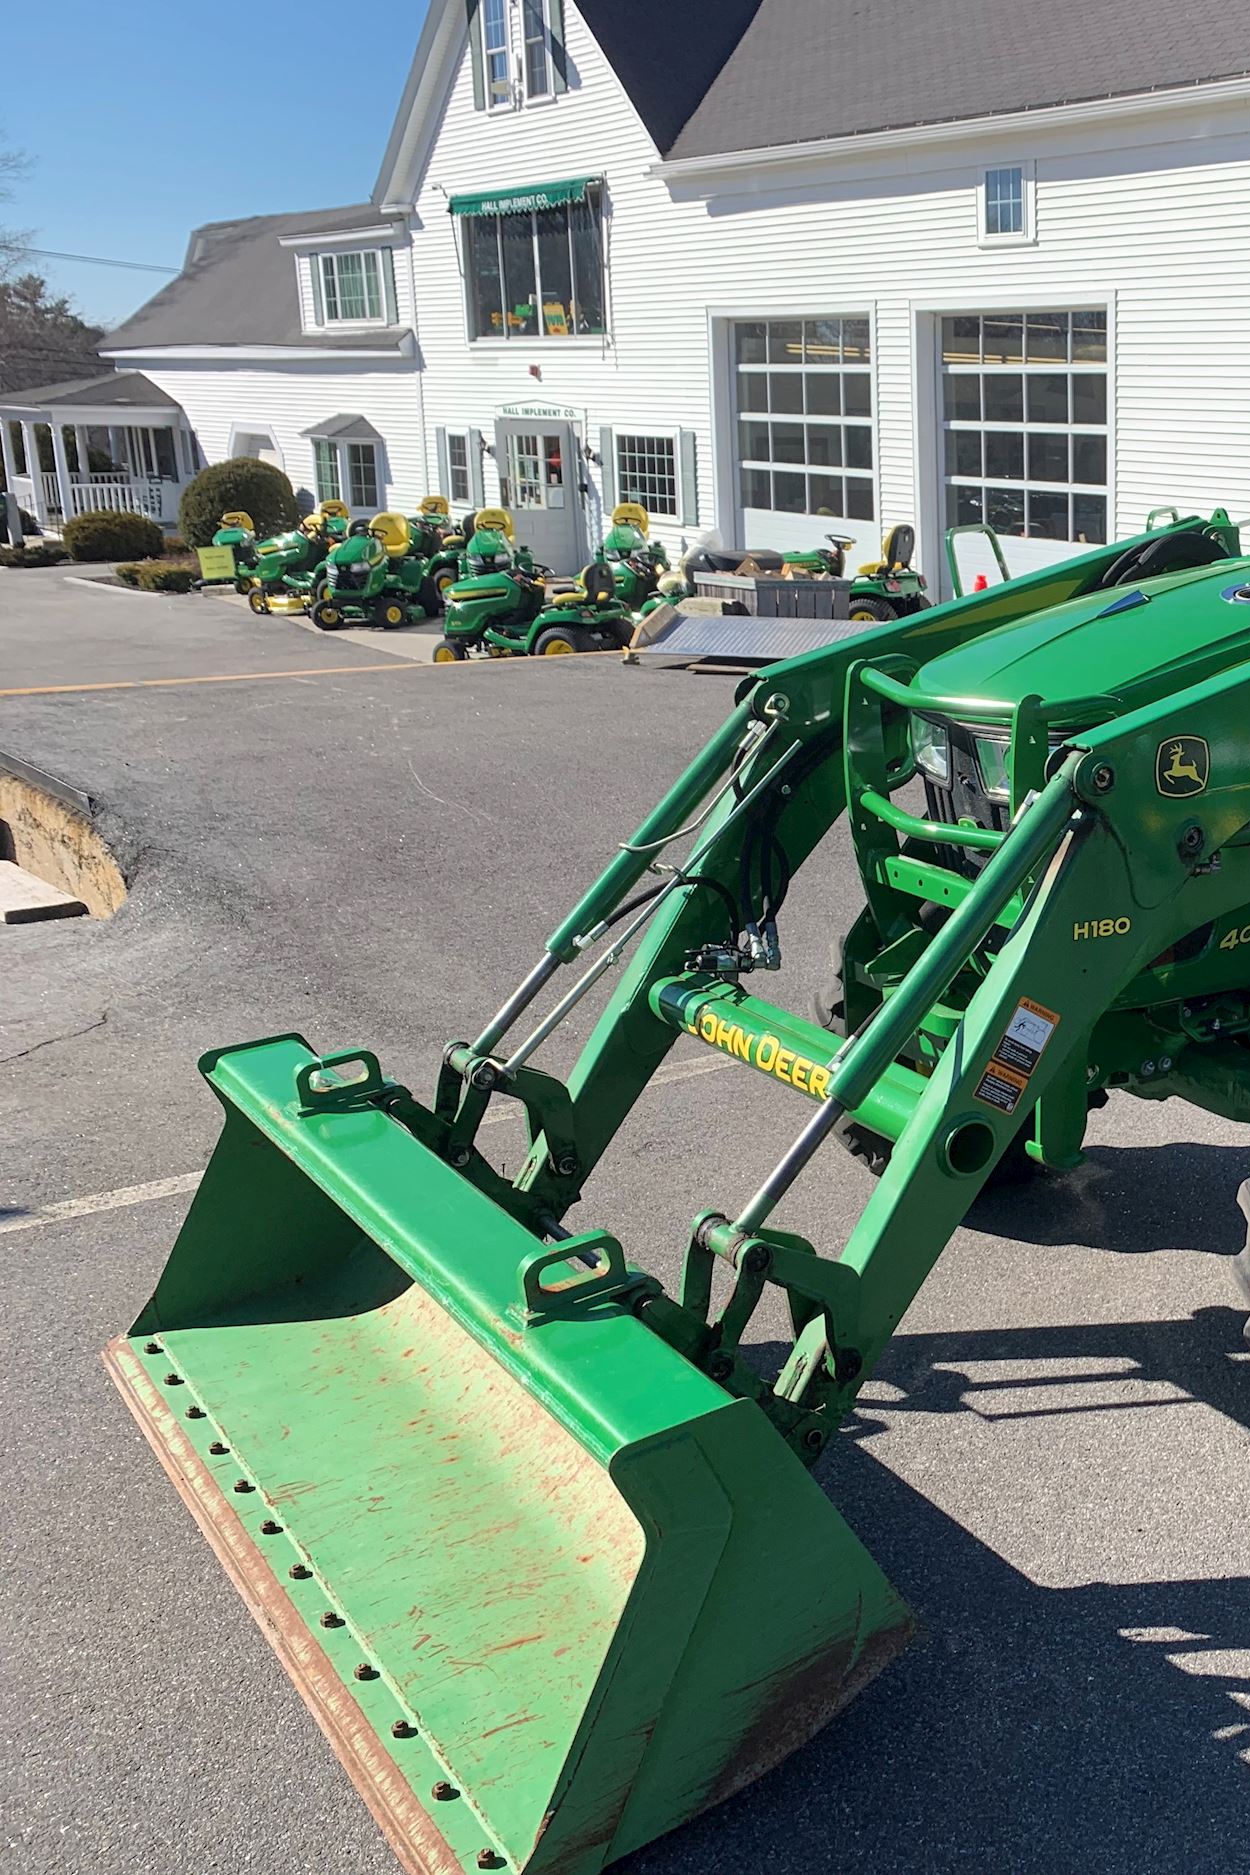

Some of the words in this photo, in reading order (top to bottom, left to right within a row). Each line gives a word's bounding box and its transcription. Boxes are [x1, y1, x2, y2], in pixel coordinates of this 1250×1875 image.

[481, 200, 498, 212] HALL
[498, 195, 535, 209] IMPLEMENT
[503, 407, 519, 415] HALL
[522, 407, 561, 417] IMPLEMENT
[564, 408, 577, 418] CO.
[1073, 916, 1131, 941] H180
